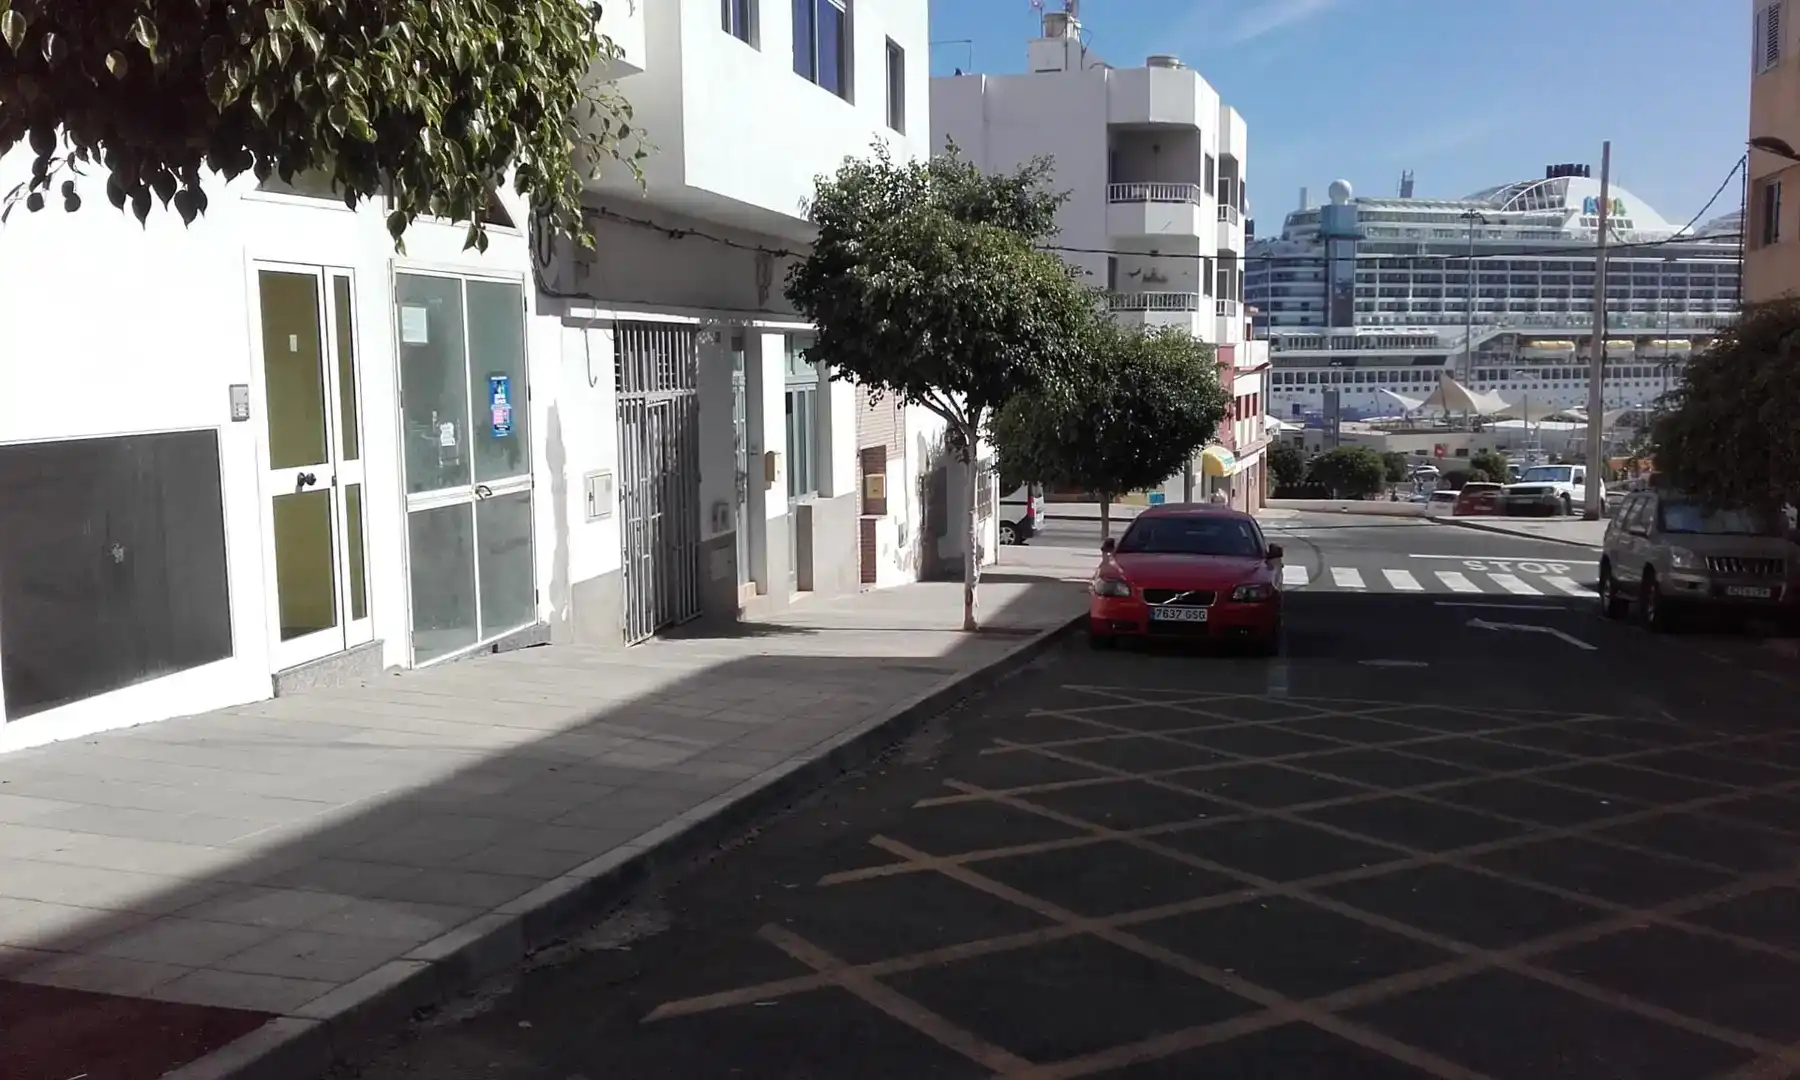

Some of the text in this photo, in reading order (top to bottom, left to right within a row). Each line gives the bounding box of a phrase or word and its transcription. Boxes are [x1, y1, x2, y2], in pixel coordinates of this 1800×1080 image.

[1582, 196, 1627, 217] ADA
[1462, 560, 1571, 574] STOP
[1155, 608, 1182, 620] 7637
